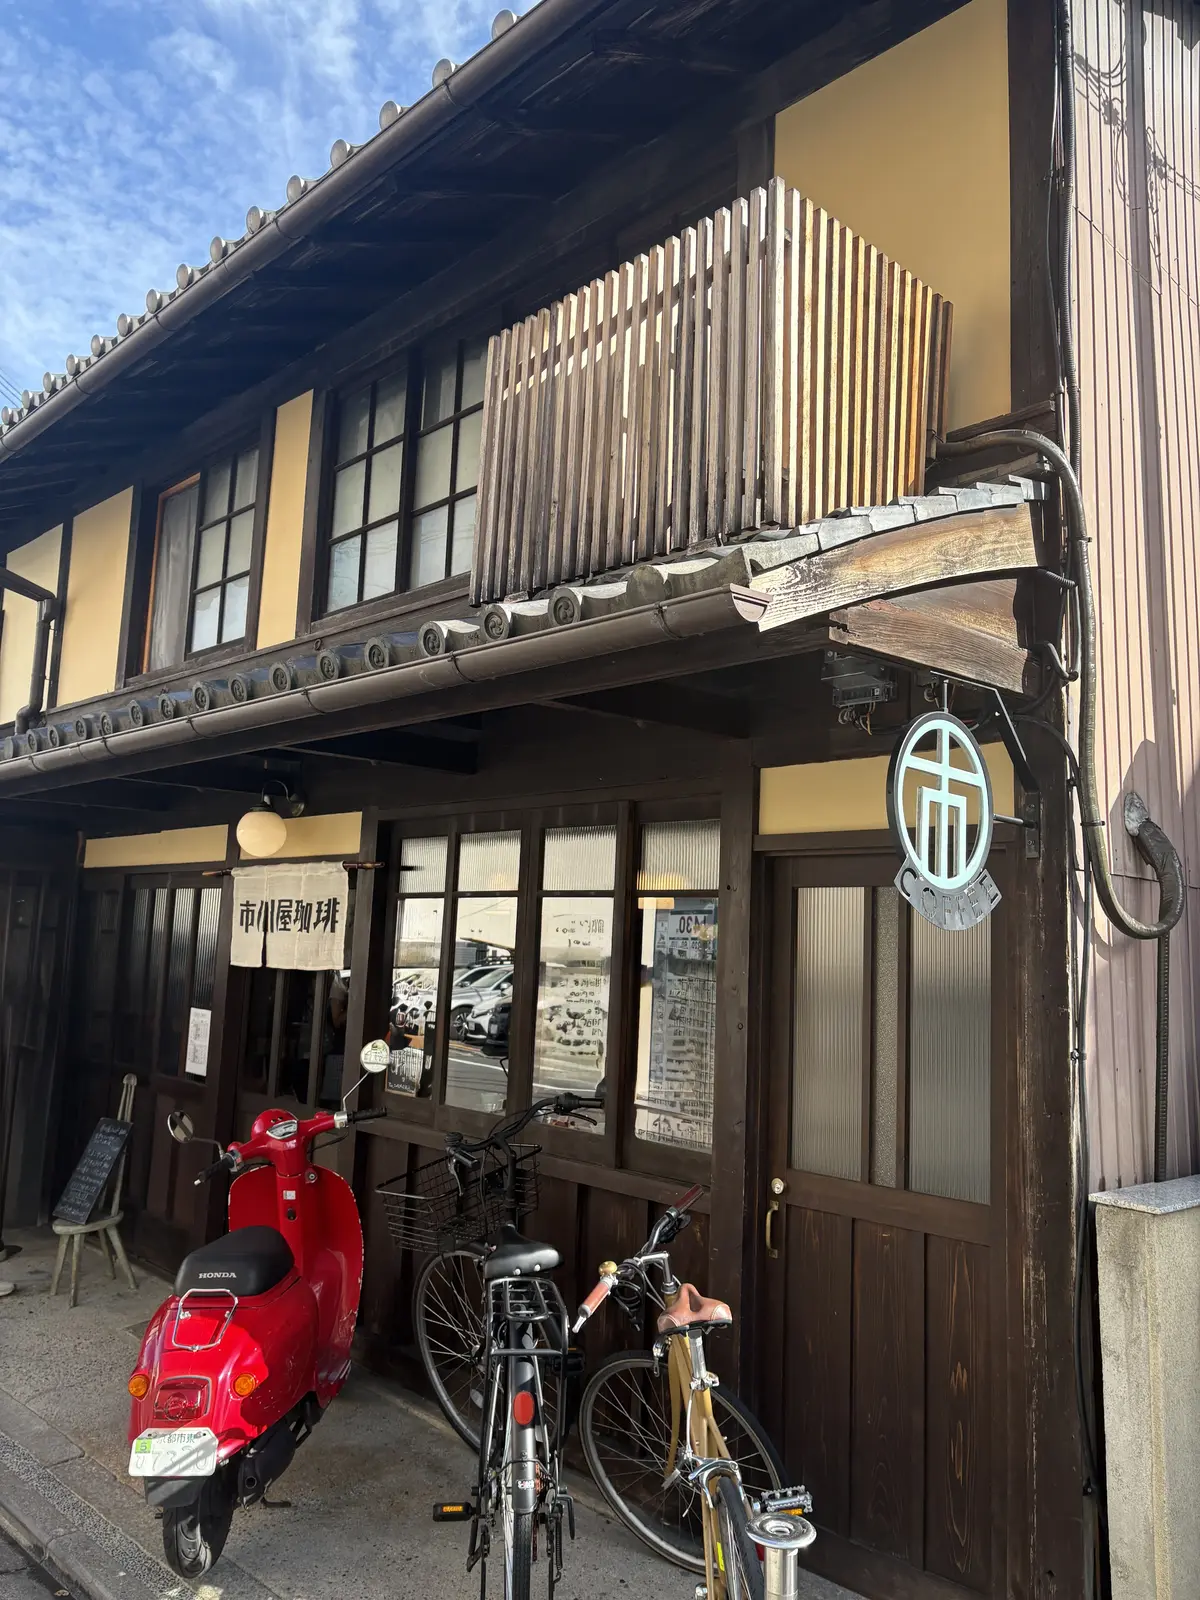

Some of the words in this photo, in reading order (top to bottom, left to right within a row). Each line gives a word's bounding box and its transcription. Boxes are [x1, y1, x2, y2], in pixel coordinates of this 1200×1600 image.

[240, 897, 340, 933] 市川屋珈琲
[900, 867, 999, 926] COFFEE
